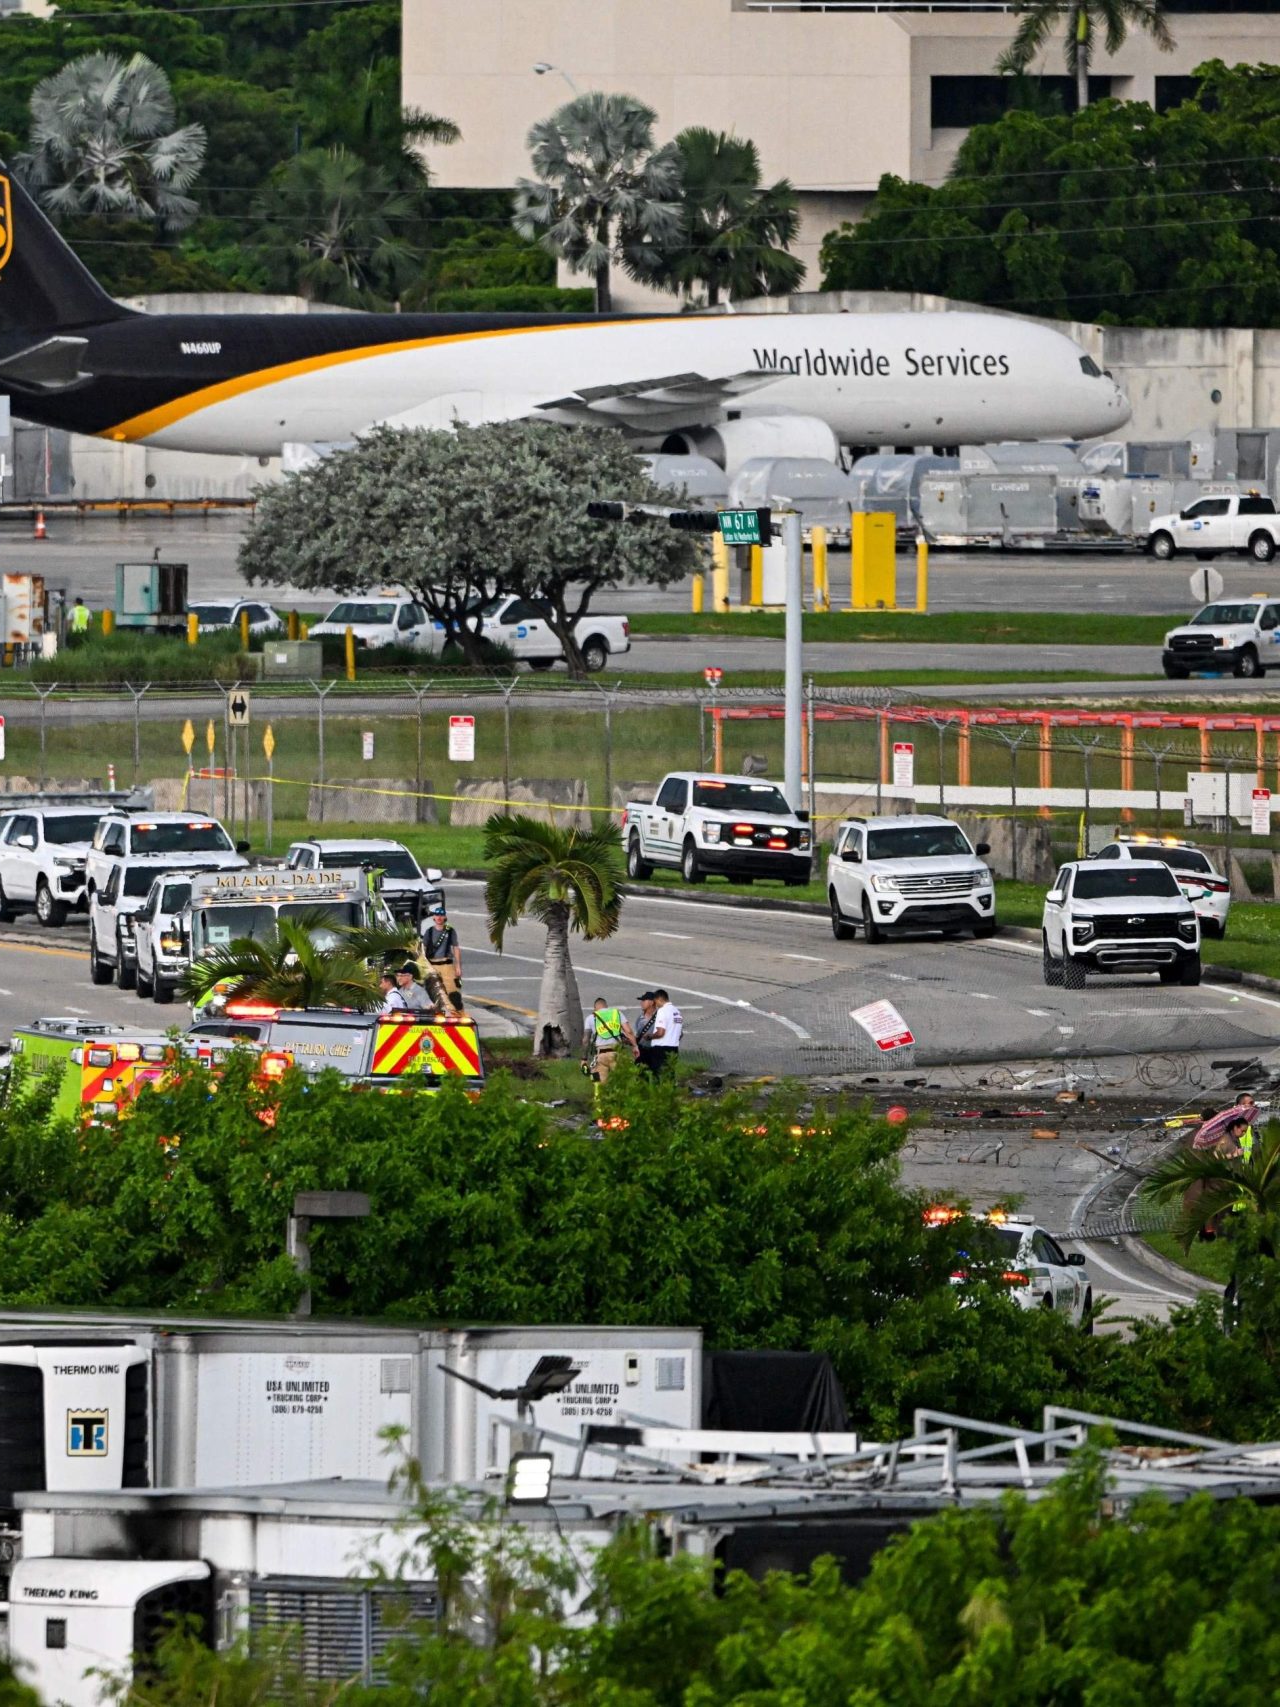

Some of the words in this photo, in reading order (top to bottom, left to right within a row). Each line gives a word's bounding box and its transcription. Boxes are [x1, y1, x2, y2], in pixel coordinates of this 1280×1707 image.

[753, 348, 890, 376] Worldwide
[905, 347, 1009, 376] Services
[723, 515, 732, 528] NW
[735, 513, 744, 529] 67
[747, 515, 755, 528] AV
[285, 1041, 327, 1056] BATTALION
[329, 1045, 352, 1057] CHIEF
[53, 1365, 97, 1375] THERMO
[98, 1364, 120, 1374] KING
[266, 1380, 282, 1392] USA
[285, 1381, 330, 1392] UNLIMITED
[575, 1383, 619, 1394] UNLIMITED
[273, 1393, 304, 1402] TRUCKING
[306, 1394, 322, 1402] CORP
[563, 1396, 592, 1404] TRUCKING
[595, 1396, 612, 1404] CORP
[23, 1587, 66, 1598] THERMO
[69, 1589, 99, 1600] KING
